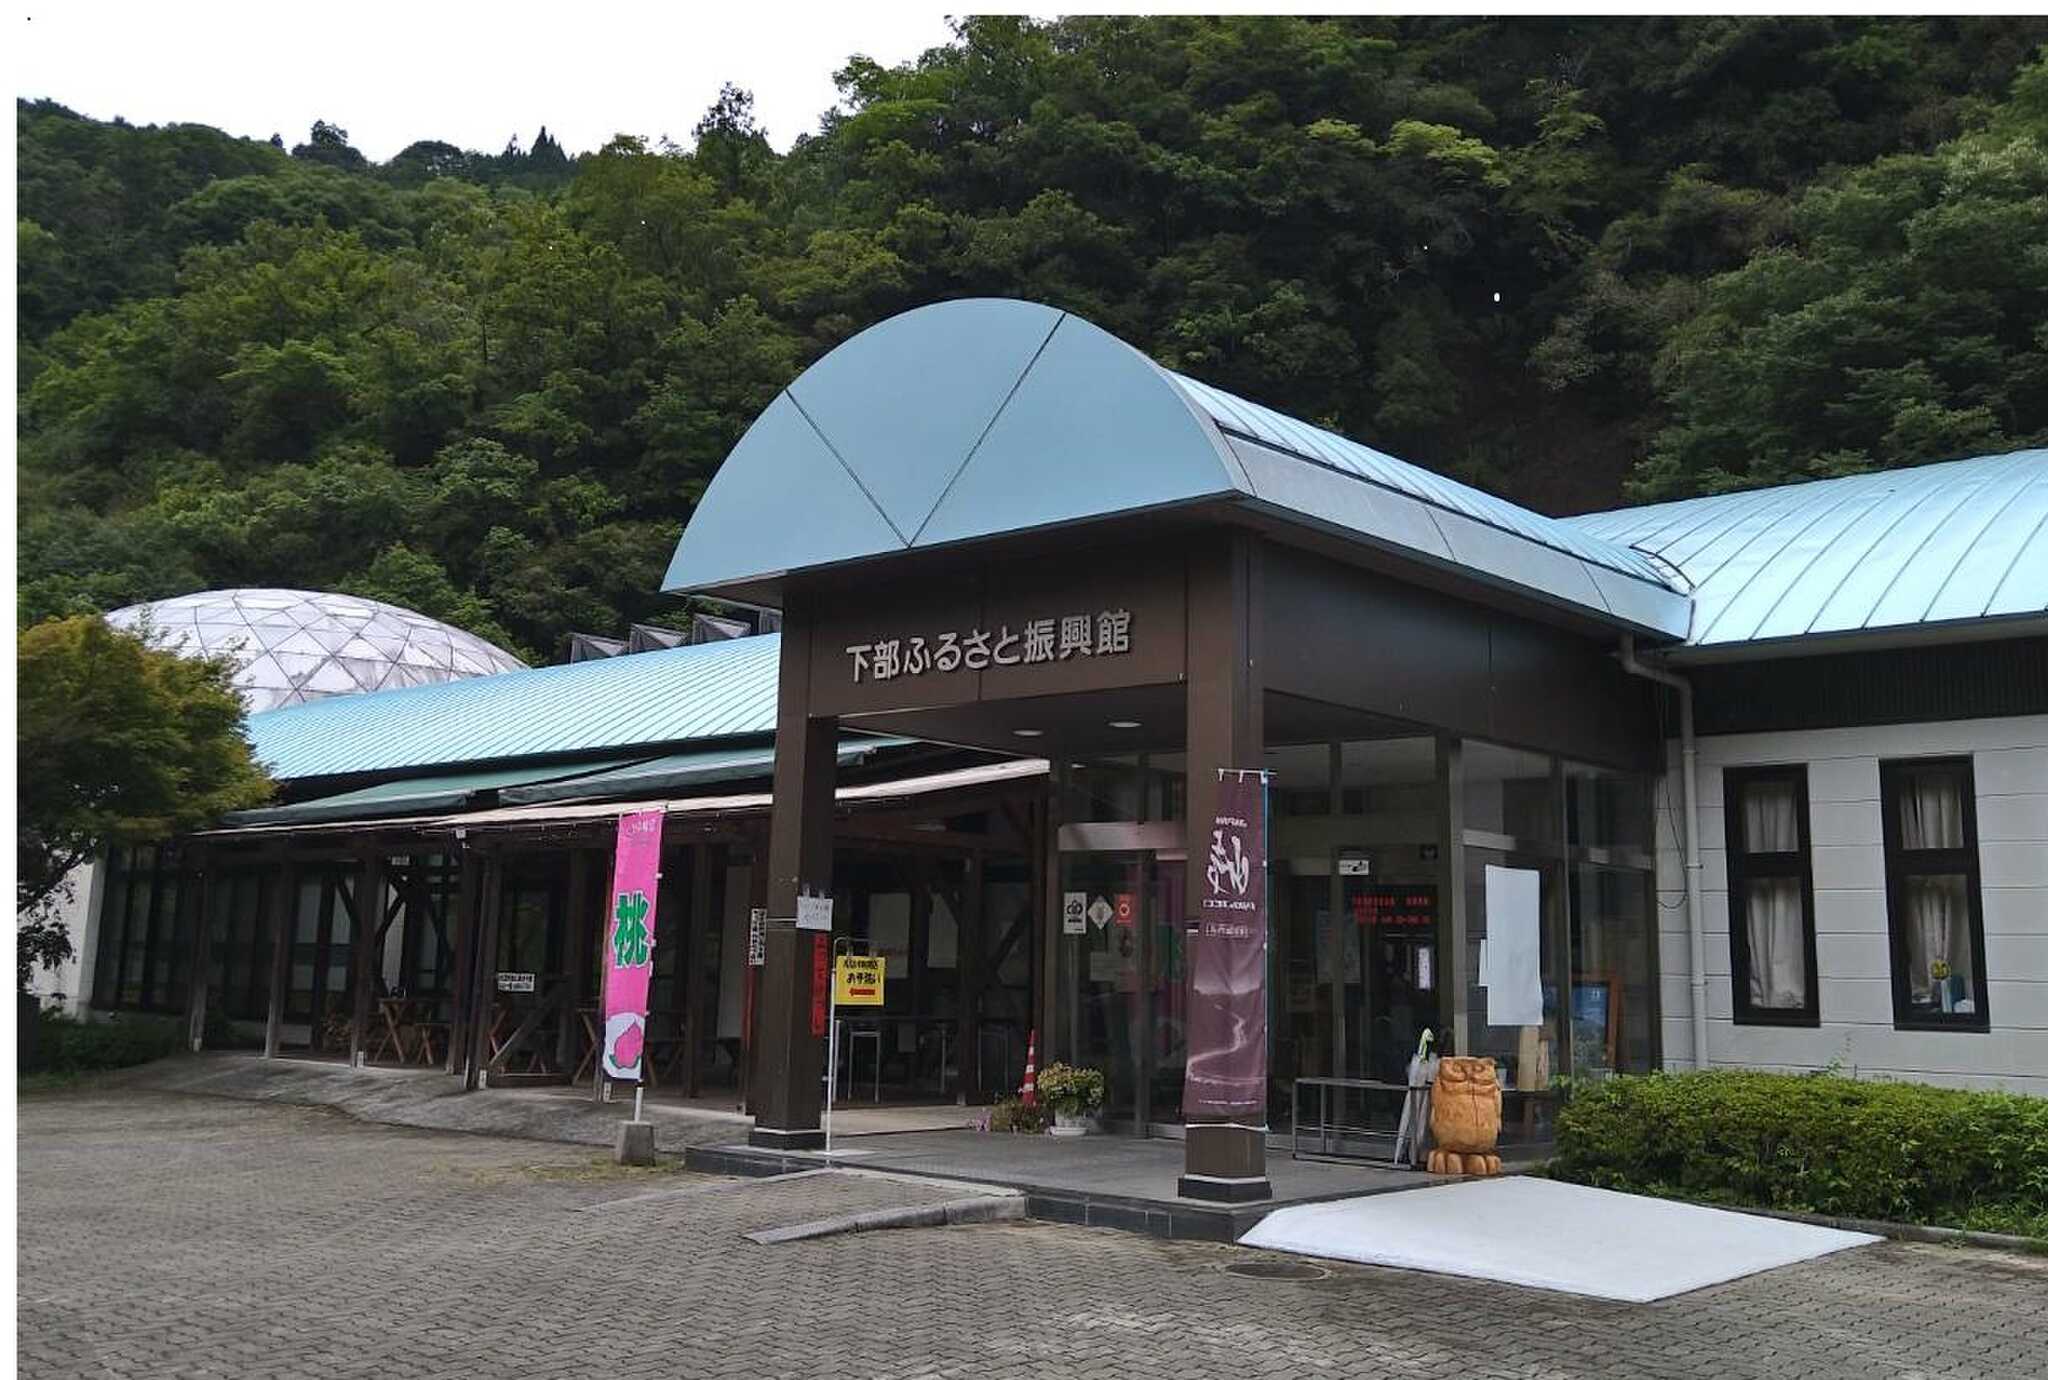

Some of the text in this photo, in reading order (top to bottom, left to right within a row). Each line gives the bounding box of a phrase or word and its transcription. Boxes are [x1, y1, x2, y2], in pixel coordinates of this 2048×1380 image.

[846, 609, 1131, 682] 下部ふるさと振興館
[614, 892, 650, 967] 桃
